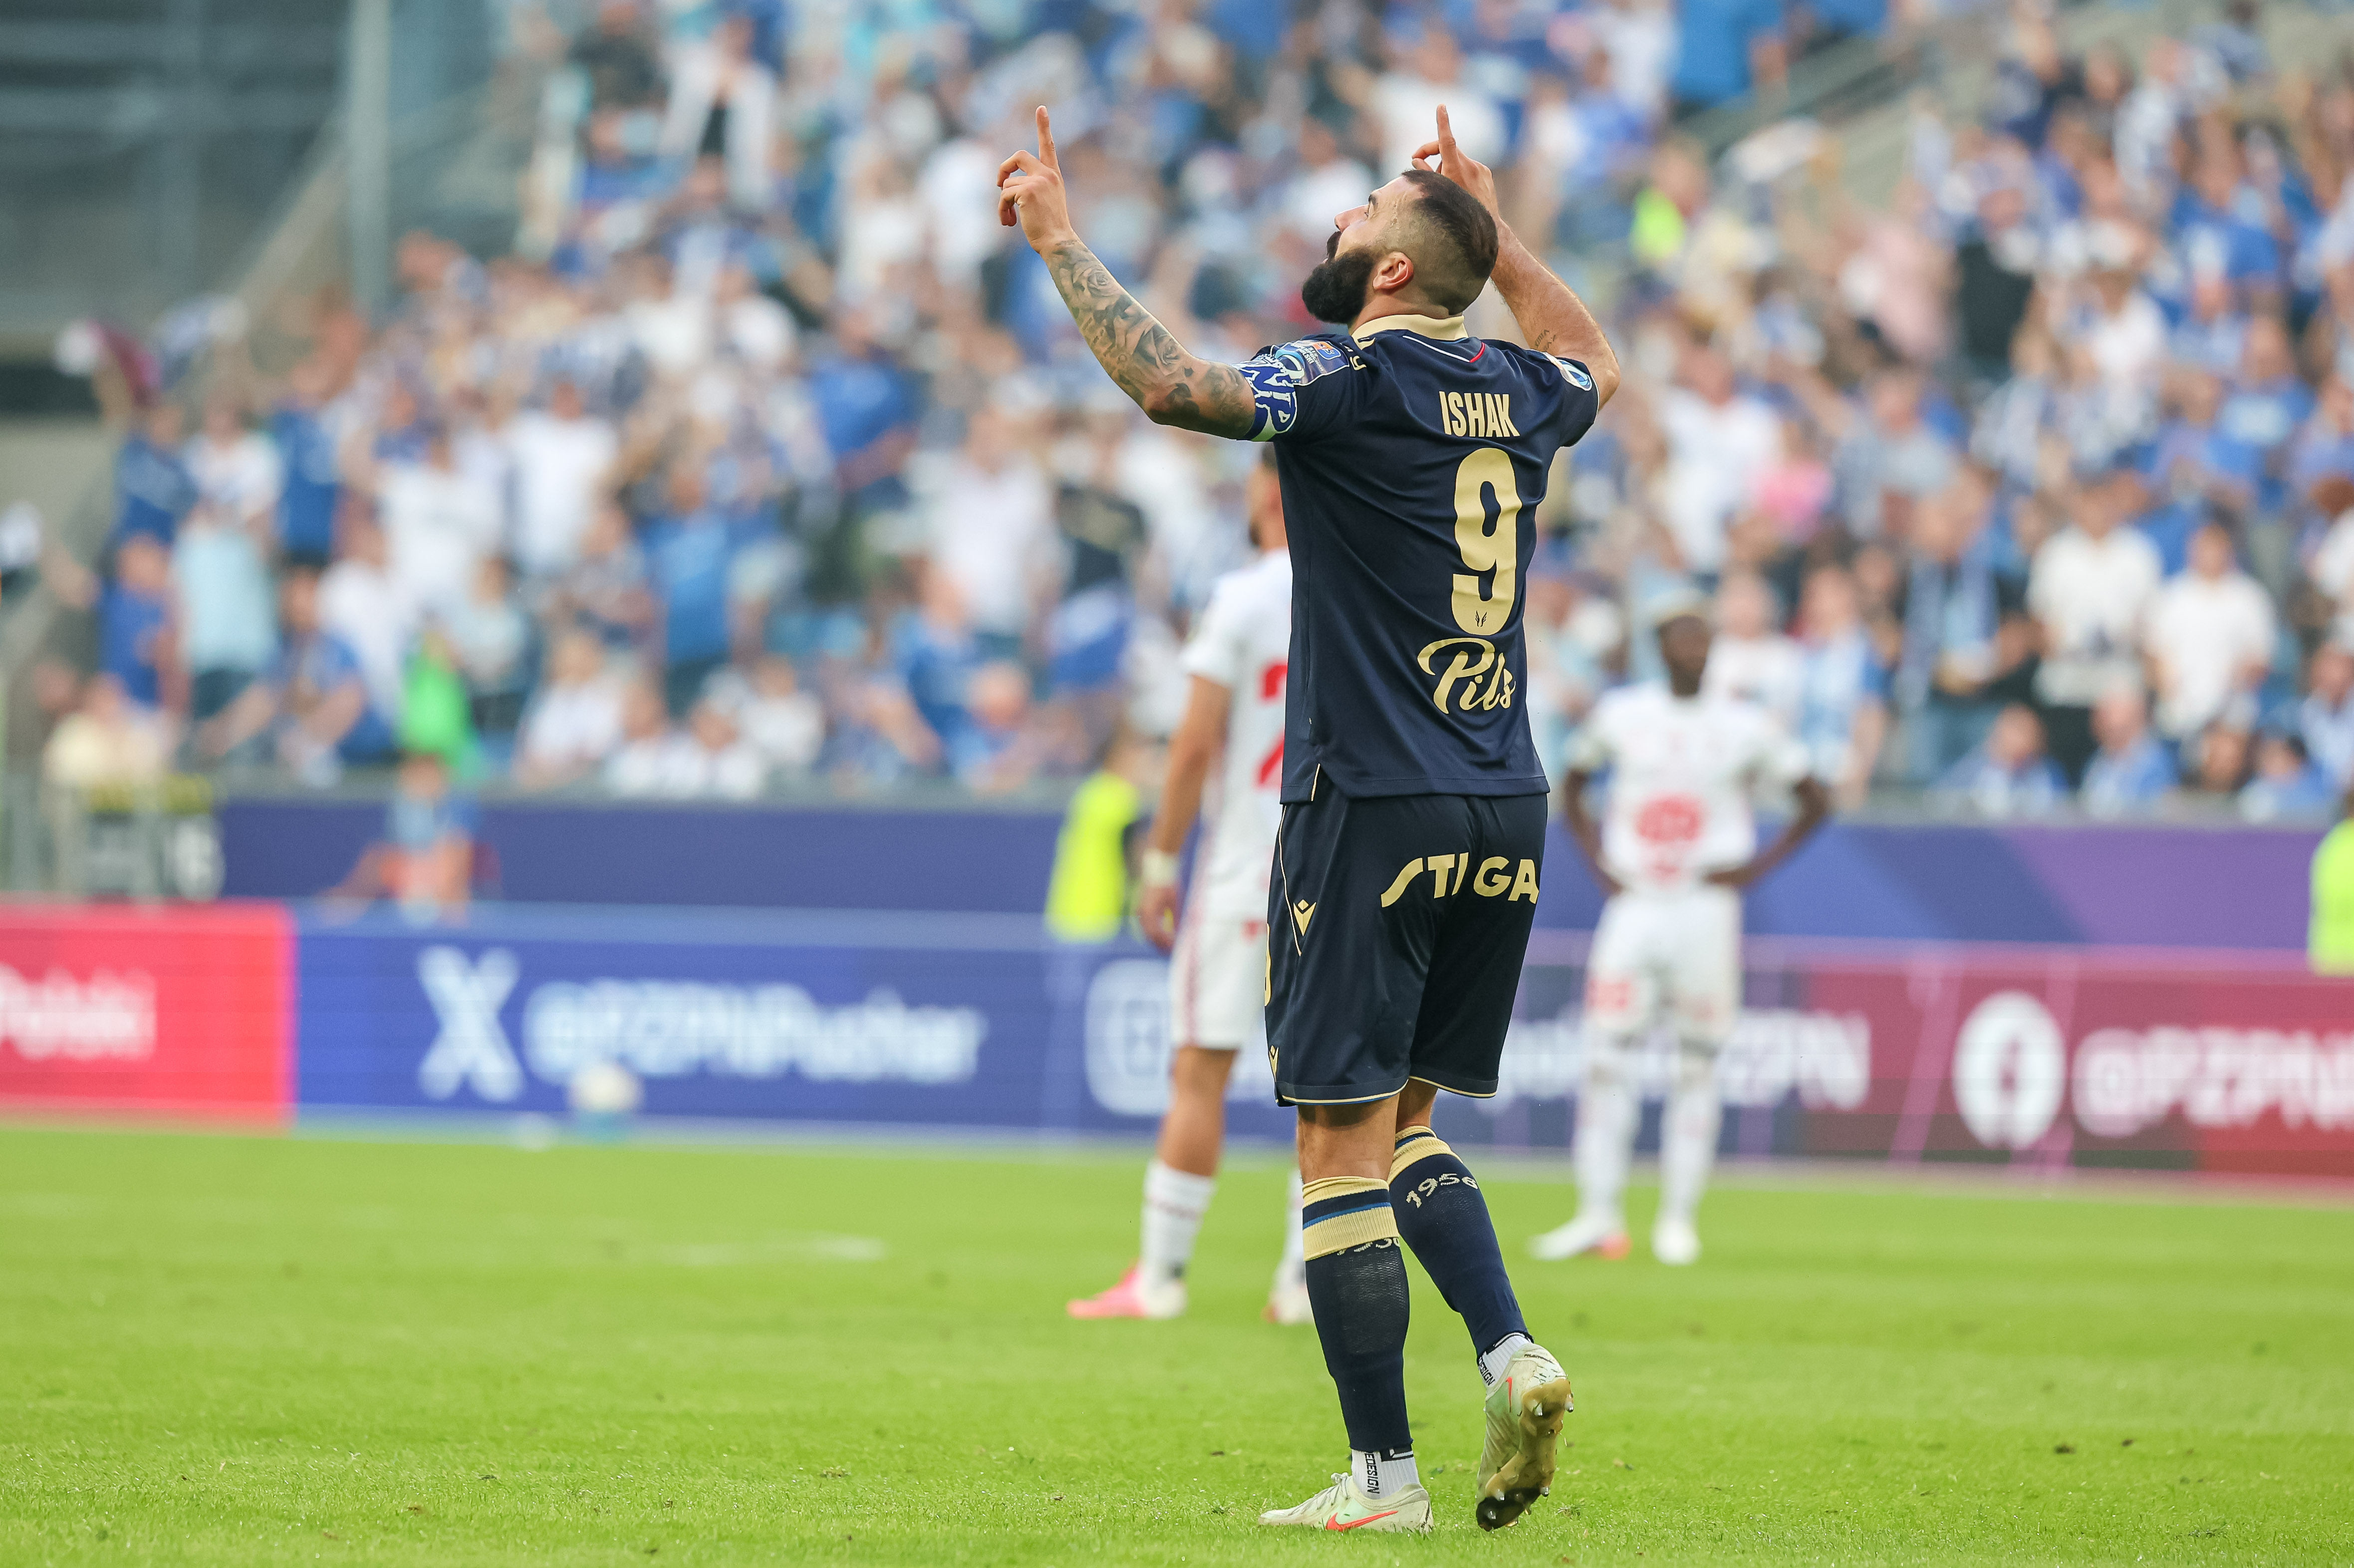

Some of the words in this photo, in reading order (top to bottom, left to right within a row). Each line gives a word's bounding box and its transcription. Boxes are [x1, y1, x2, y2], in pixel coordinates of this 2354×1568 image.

[1439, 391, 1520, 437] ISHAK
[1451, 448, 1523, 636] 9
[1417, 637, 1516, 714] Pils
[1381, 852, 1540, 908] STIGA
[1406, 1173, 1478, 1208] 1956
